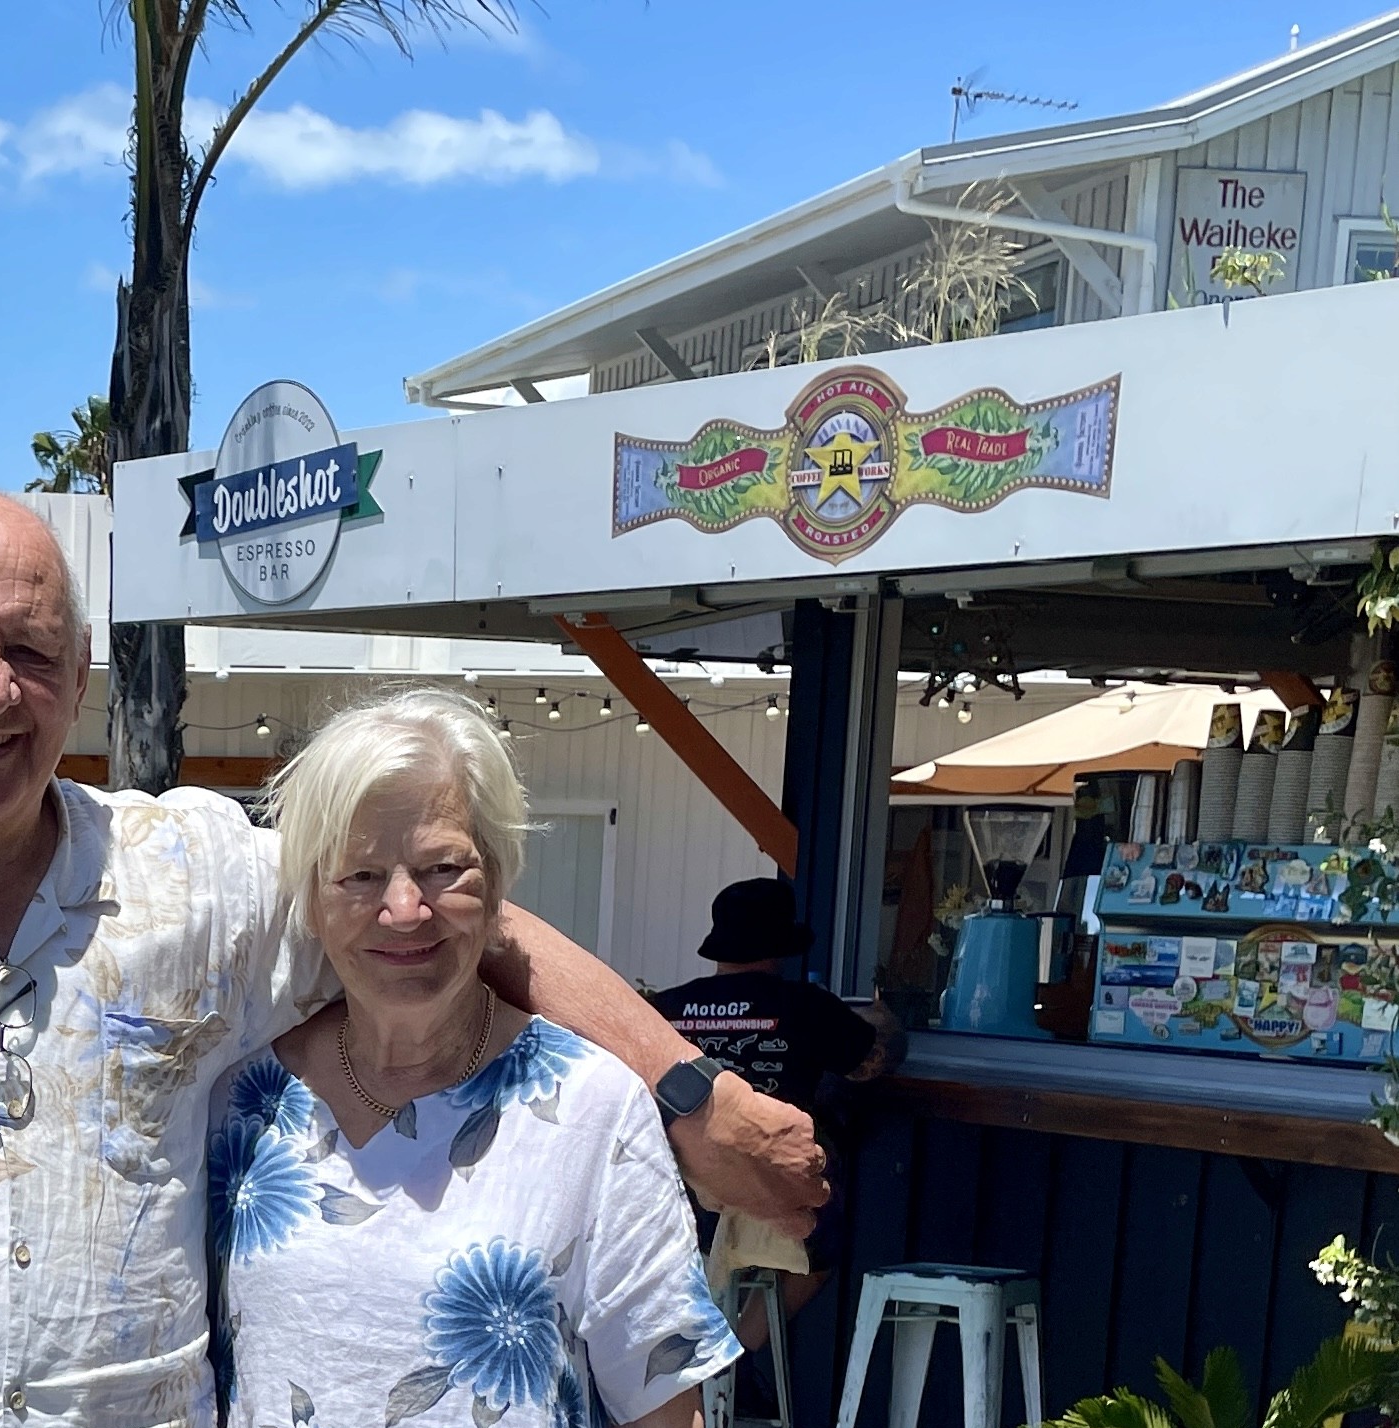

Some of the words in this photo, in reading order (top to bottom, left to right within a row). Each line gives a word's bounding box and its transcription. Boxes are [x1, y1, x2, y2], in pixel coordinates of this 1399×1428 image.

[1218, 178, 1265, 209] The
[1178, 216, 1297, 251] Waiheke
[816, 383, 843, 403] HOT
[849, 382, 874, 397] AIR
[946, 430, 971, 453] REAL
[976, 435, 1007, 456] TRADE
[699, 458, 740, 486] ORGANIC
[212, 459, 341, 533] Doubleshot
[805, 523, 870, 544] ROASTED
[237, 539, 316, 562] ESPRESSO
[259, 564, 289, 581] BAR
[683, 1002, 750, 1017] MotoGP
[695, 1019, 775, 1030] CHAMPIONSHIP
